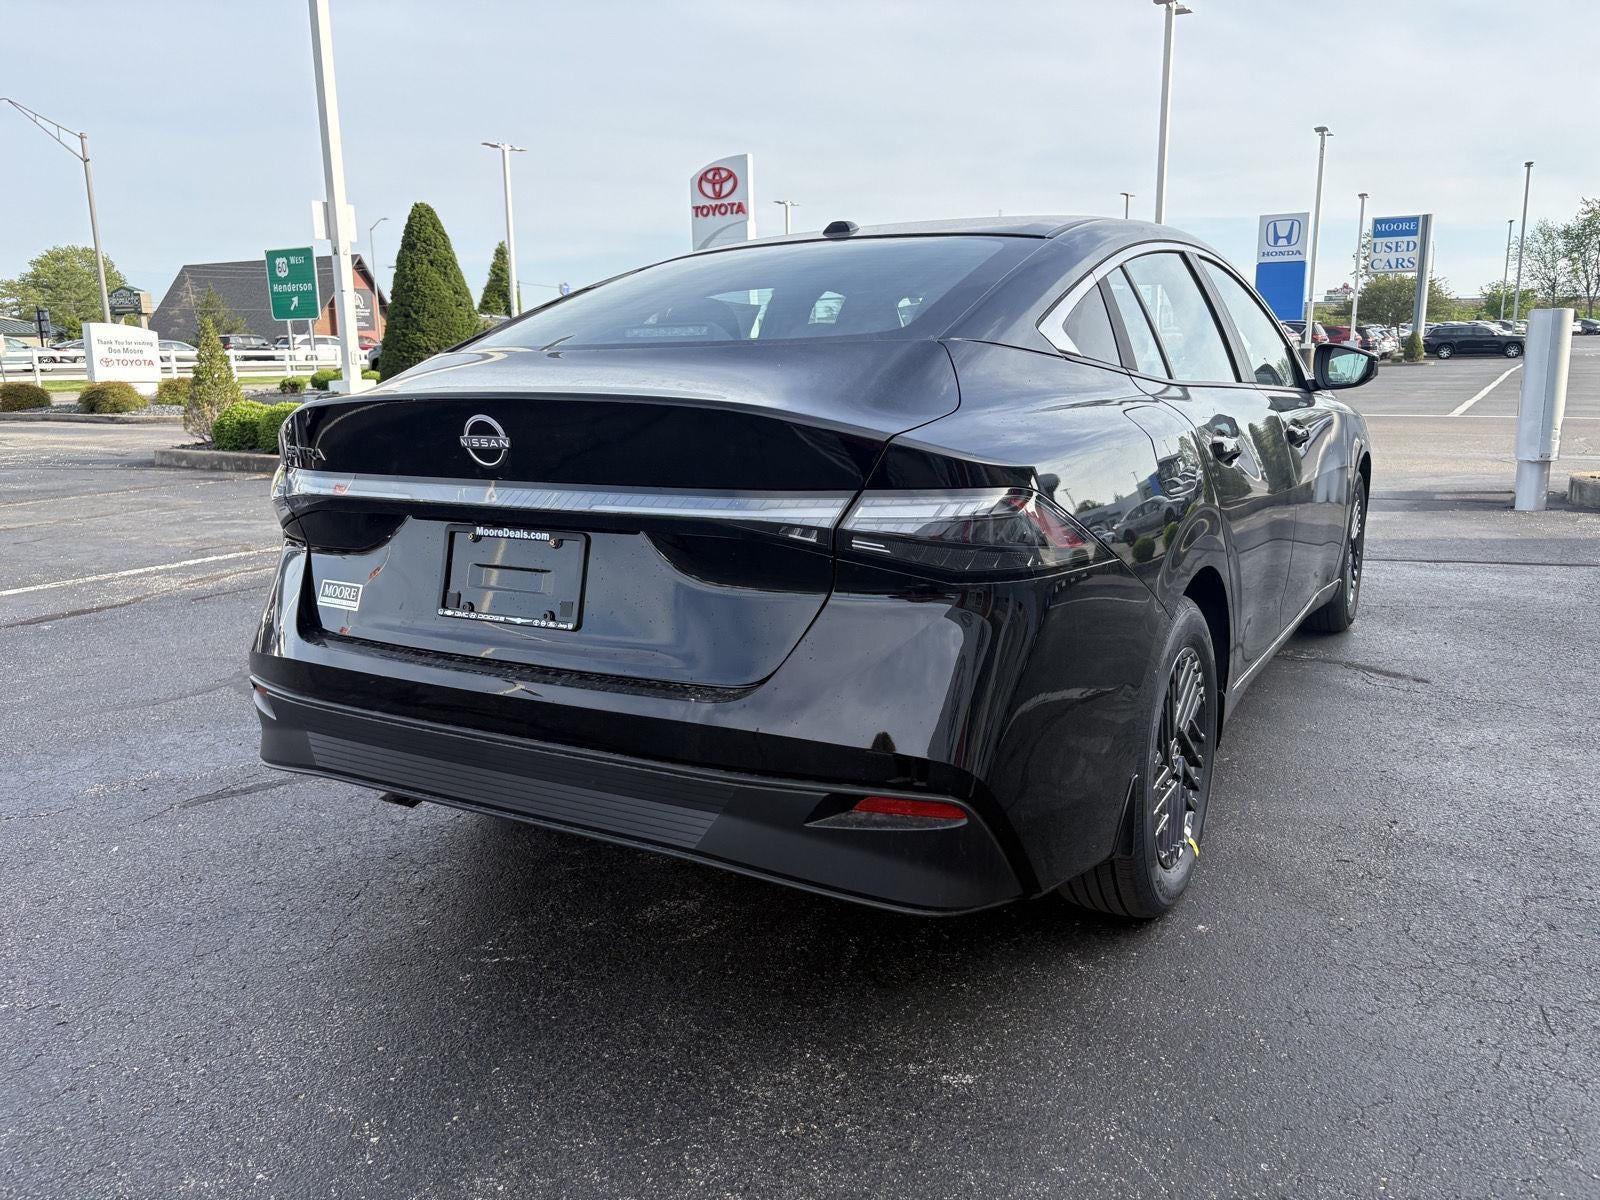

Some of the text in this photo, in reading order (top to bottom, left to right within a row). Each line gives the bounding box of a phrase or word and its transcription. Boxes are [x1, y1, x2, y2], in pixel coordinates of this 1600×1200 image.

[692, 202, 746, 217] TOYOTA
[1375, 221, 1417, 232] MOORE
[1372, 240, 1417, 254] USED
[277, 256, 305, 273] 60 WEST
[1370, 257, 1416, 270] CARS
[273, 282, 313, 292] Henderson
[122, 347, 144, 355] Moore
[114, 359, 155, 367] TOYOTA
[460, 438, 510, 448] NISSAN
[476, 526, 550, 541] MooreDeals.com
[323, 584, 357, 600] MOORE
